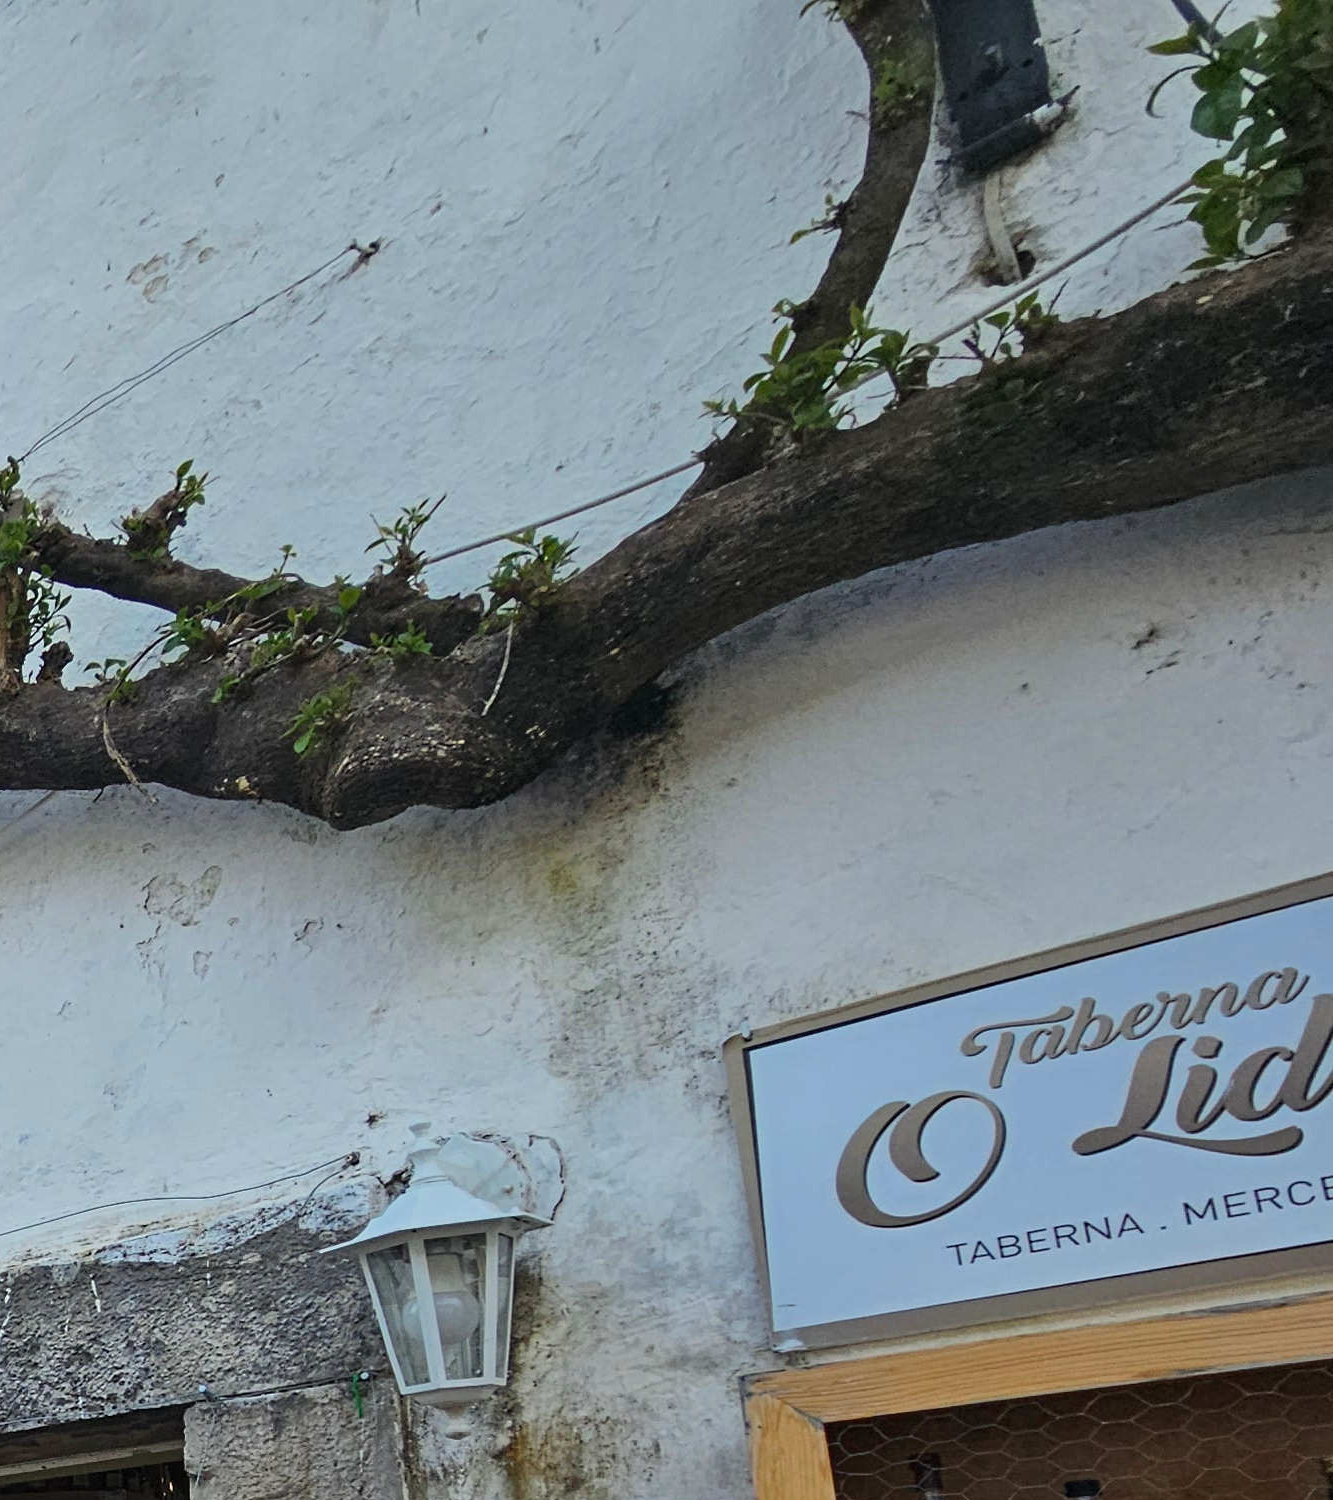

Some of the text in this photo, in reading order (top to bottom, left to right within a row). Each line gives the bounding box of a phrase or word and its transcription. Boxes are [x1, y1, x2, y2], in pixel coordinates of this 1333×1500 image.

[960, 966, 1310, 1089] Taberna
[835, 1090, 1007, 1229] O
[946, 1212, 1146, 1267] TABERNA
